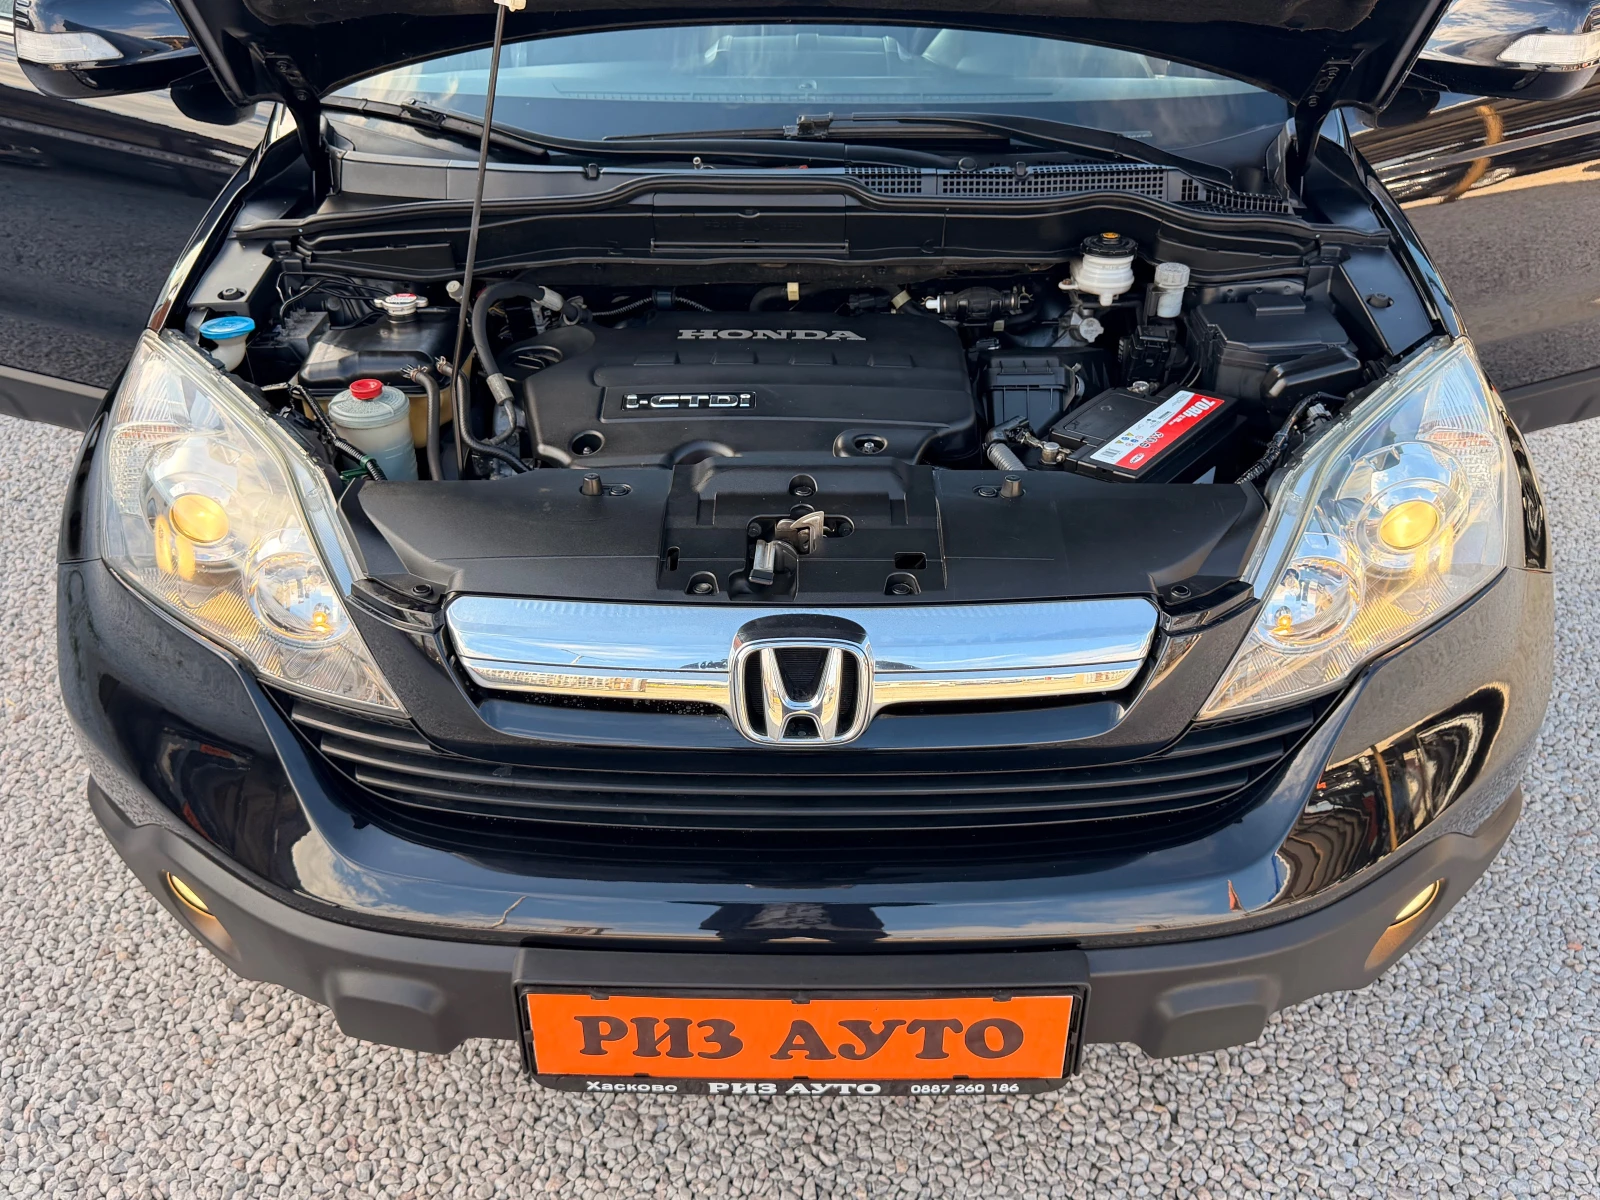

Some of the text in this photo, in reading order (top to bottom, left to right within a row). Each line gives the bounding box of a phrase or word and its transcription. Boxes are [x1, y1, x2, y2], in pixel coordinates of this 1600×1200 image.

[677, 329, 867, 341] HONDA
[574, 1016, 1024, 1061] РИЗ АУТО
[586, 1080, 1020, 1095] Хасково РИЗ АУТО 0887 260 186
